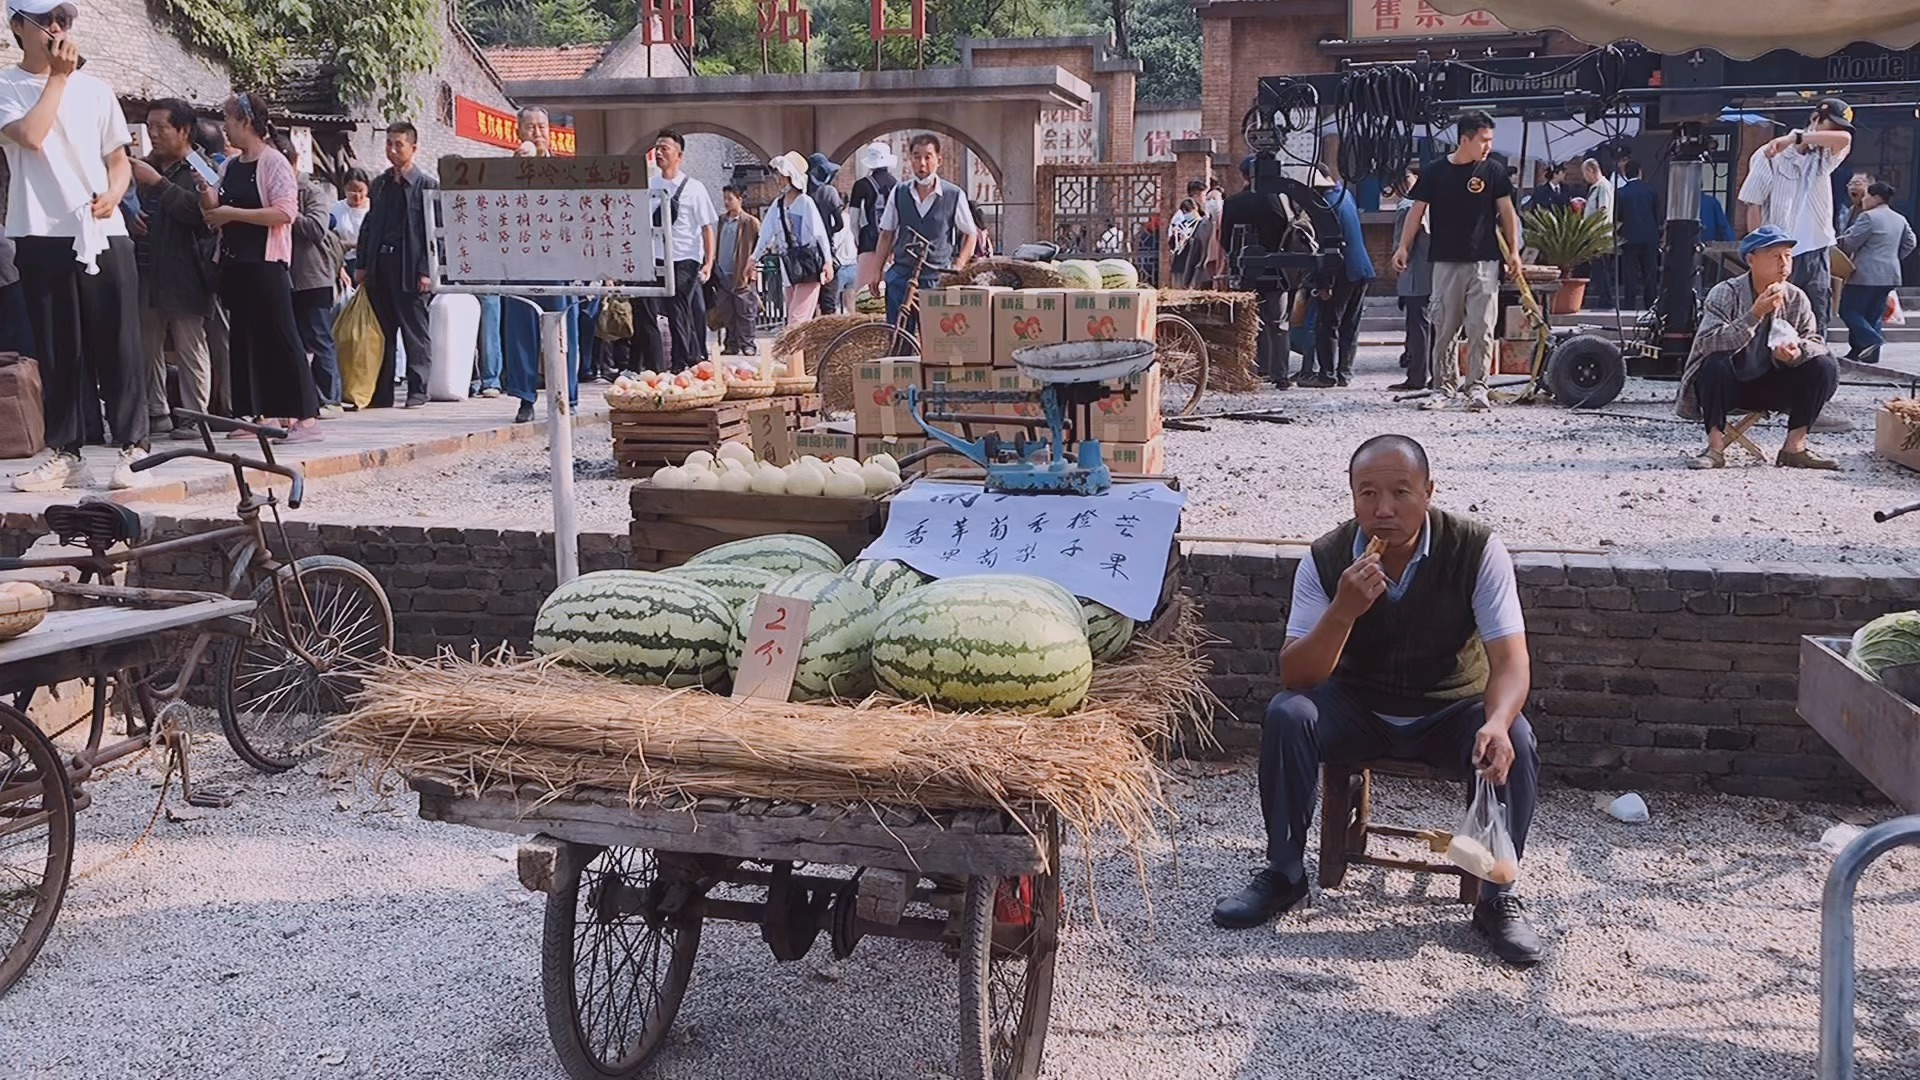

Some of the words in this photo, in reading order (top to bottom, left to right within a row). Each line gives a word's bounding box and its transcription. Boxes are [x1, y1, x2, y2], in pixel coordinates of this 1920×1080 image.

[1044, 128, 1092, 150] 会主义
[455, 162, 485, 185] 21
